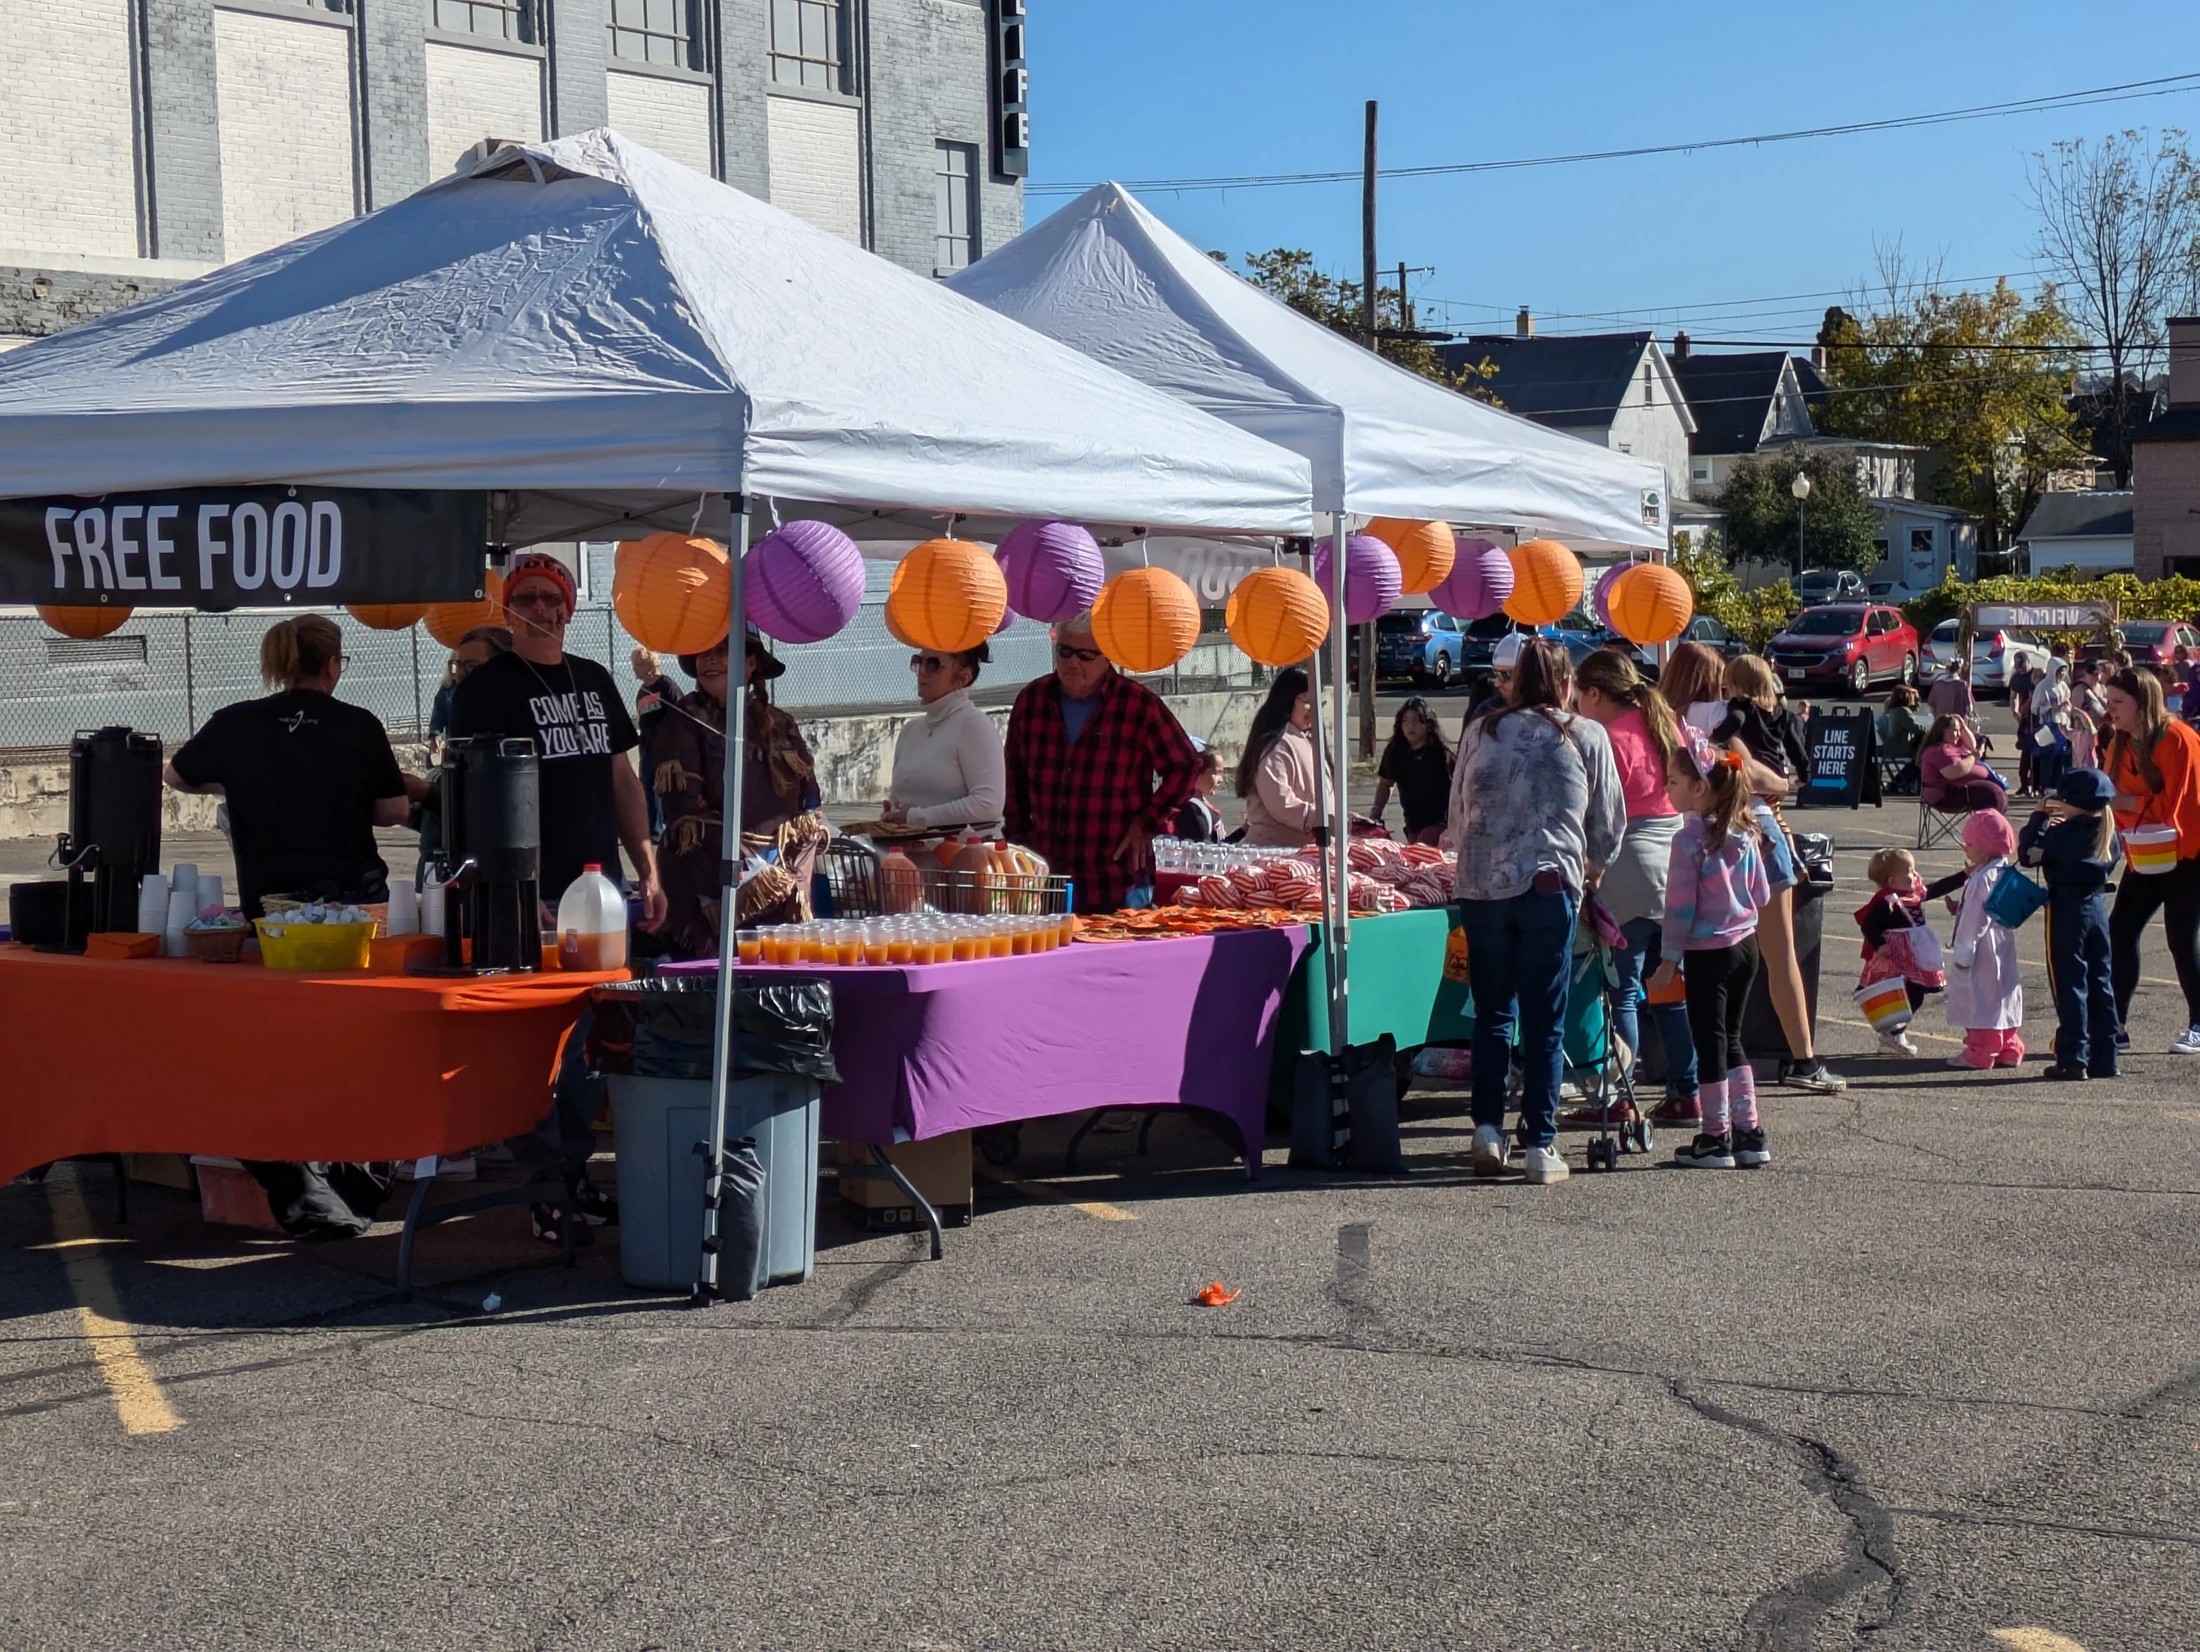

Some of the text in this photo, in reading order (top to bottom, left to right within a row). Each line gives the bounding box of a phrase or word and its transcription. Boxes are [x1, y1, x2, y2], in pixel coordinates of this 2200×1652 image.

[45, 501, 342, 590] FREE FOOD
[529, 693, 584, 726] COME
[582, 691, 605, 719] AS
[539, 723, 612, 755] YOU ARE
[1824, 730, 1849, 744] LINE
[1813, 745, 1856, 760] STARTS
[1818, 761, 1848, 775] HERE
